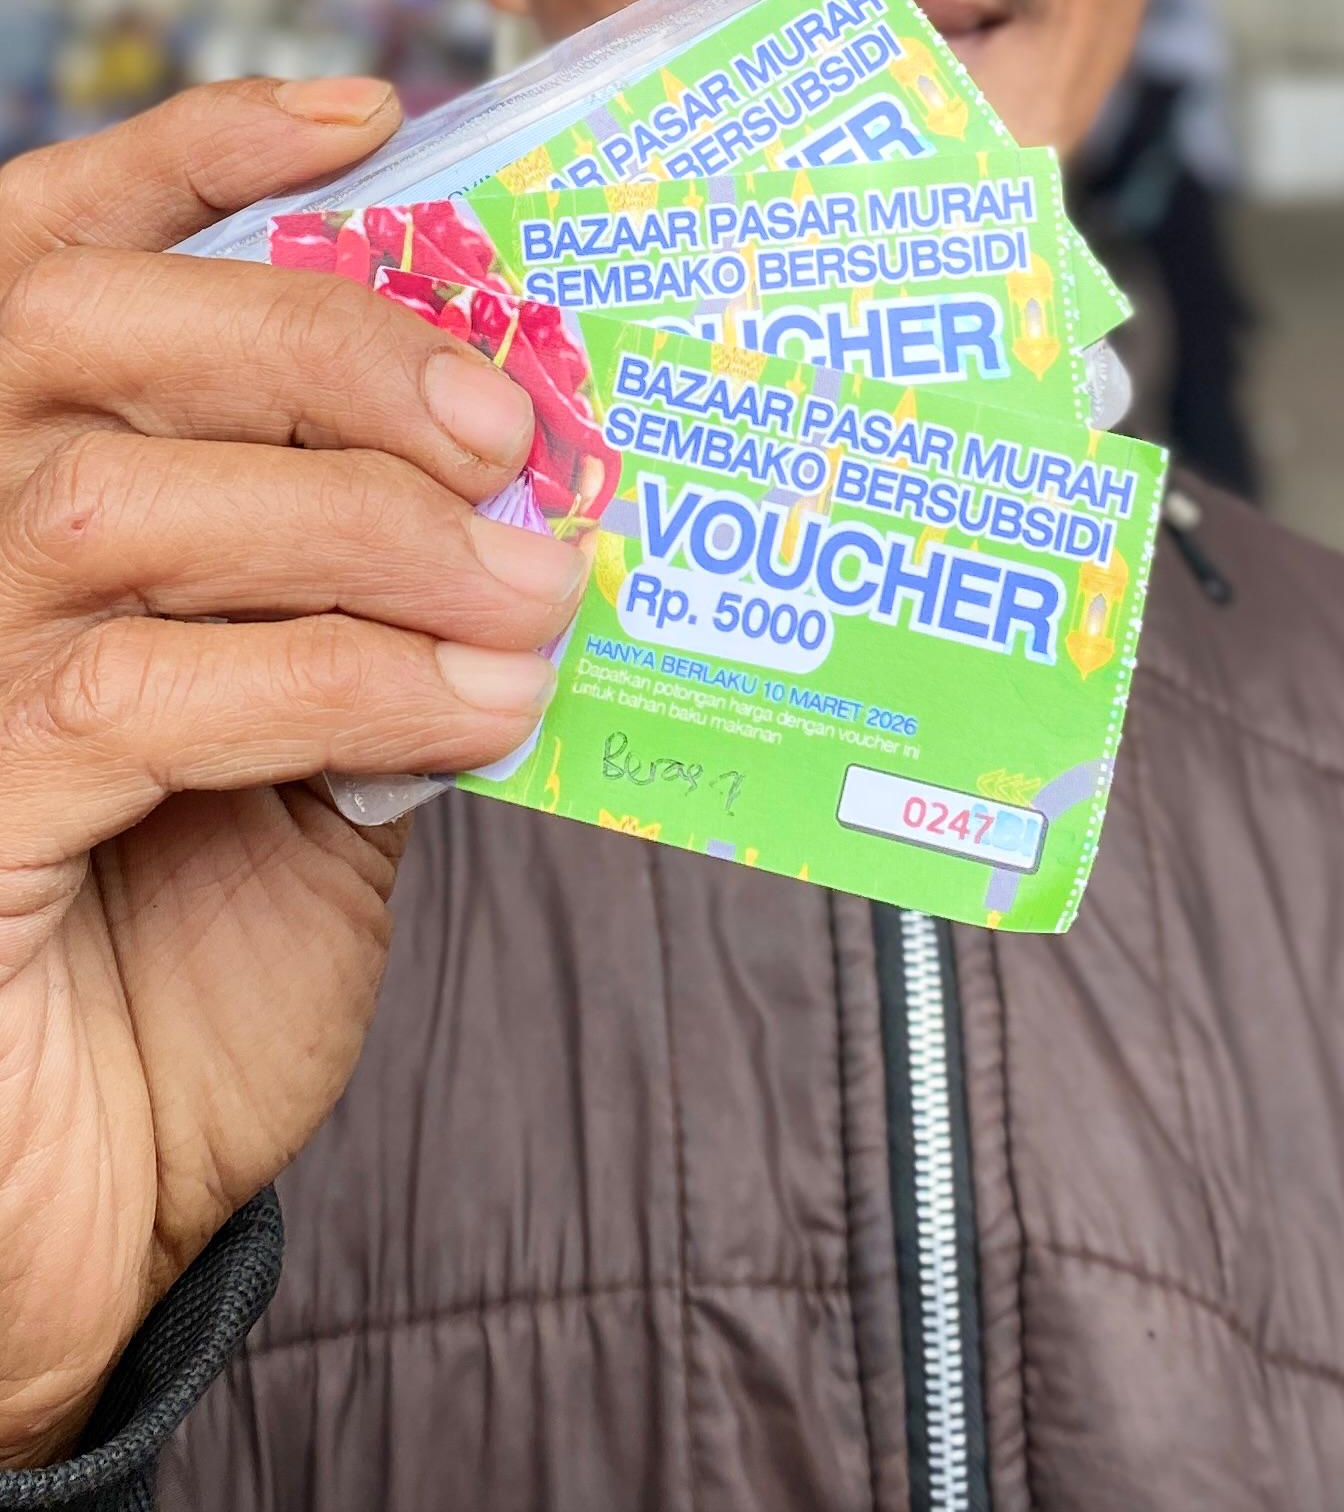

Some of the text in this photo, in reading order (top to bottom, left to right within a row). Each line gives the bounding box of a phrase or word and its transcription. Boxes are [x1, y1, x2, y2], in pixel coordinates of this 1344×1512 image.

[603, 74, 739, 176] PASAR
[524, 182, 1032, 261] BAZAAR PASAR MURAH
[527, 232, 1027, 307] SEMBAKO BERSUBSIDI
[605, 408, 1116, 562] SEMBAKO BERSUBSIDI
[618, 361, 1134, 513] BAZAAR PASAR MURAH
[626, 574, 826, 651] Rp. 5000
[643, 481, 1059, 655] VOUCHER
[573, 681, 783, 745] untuk bahan baku makanan
[577, 657, 921, 760] Dapatkan potongan harga dengan voucher ini
[586, 636, 918, 736] HANYA BERLAKU 10 MARET 2026
[902, 796, 995, 845] 0247
